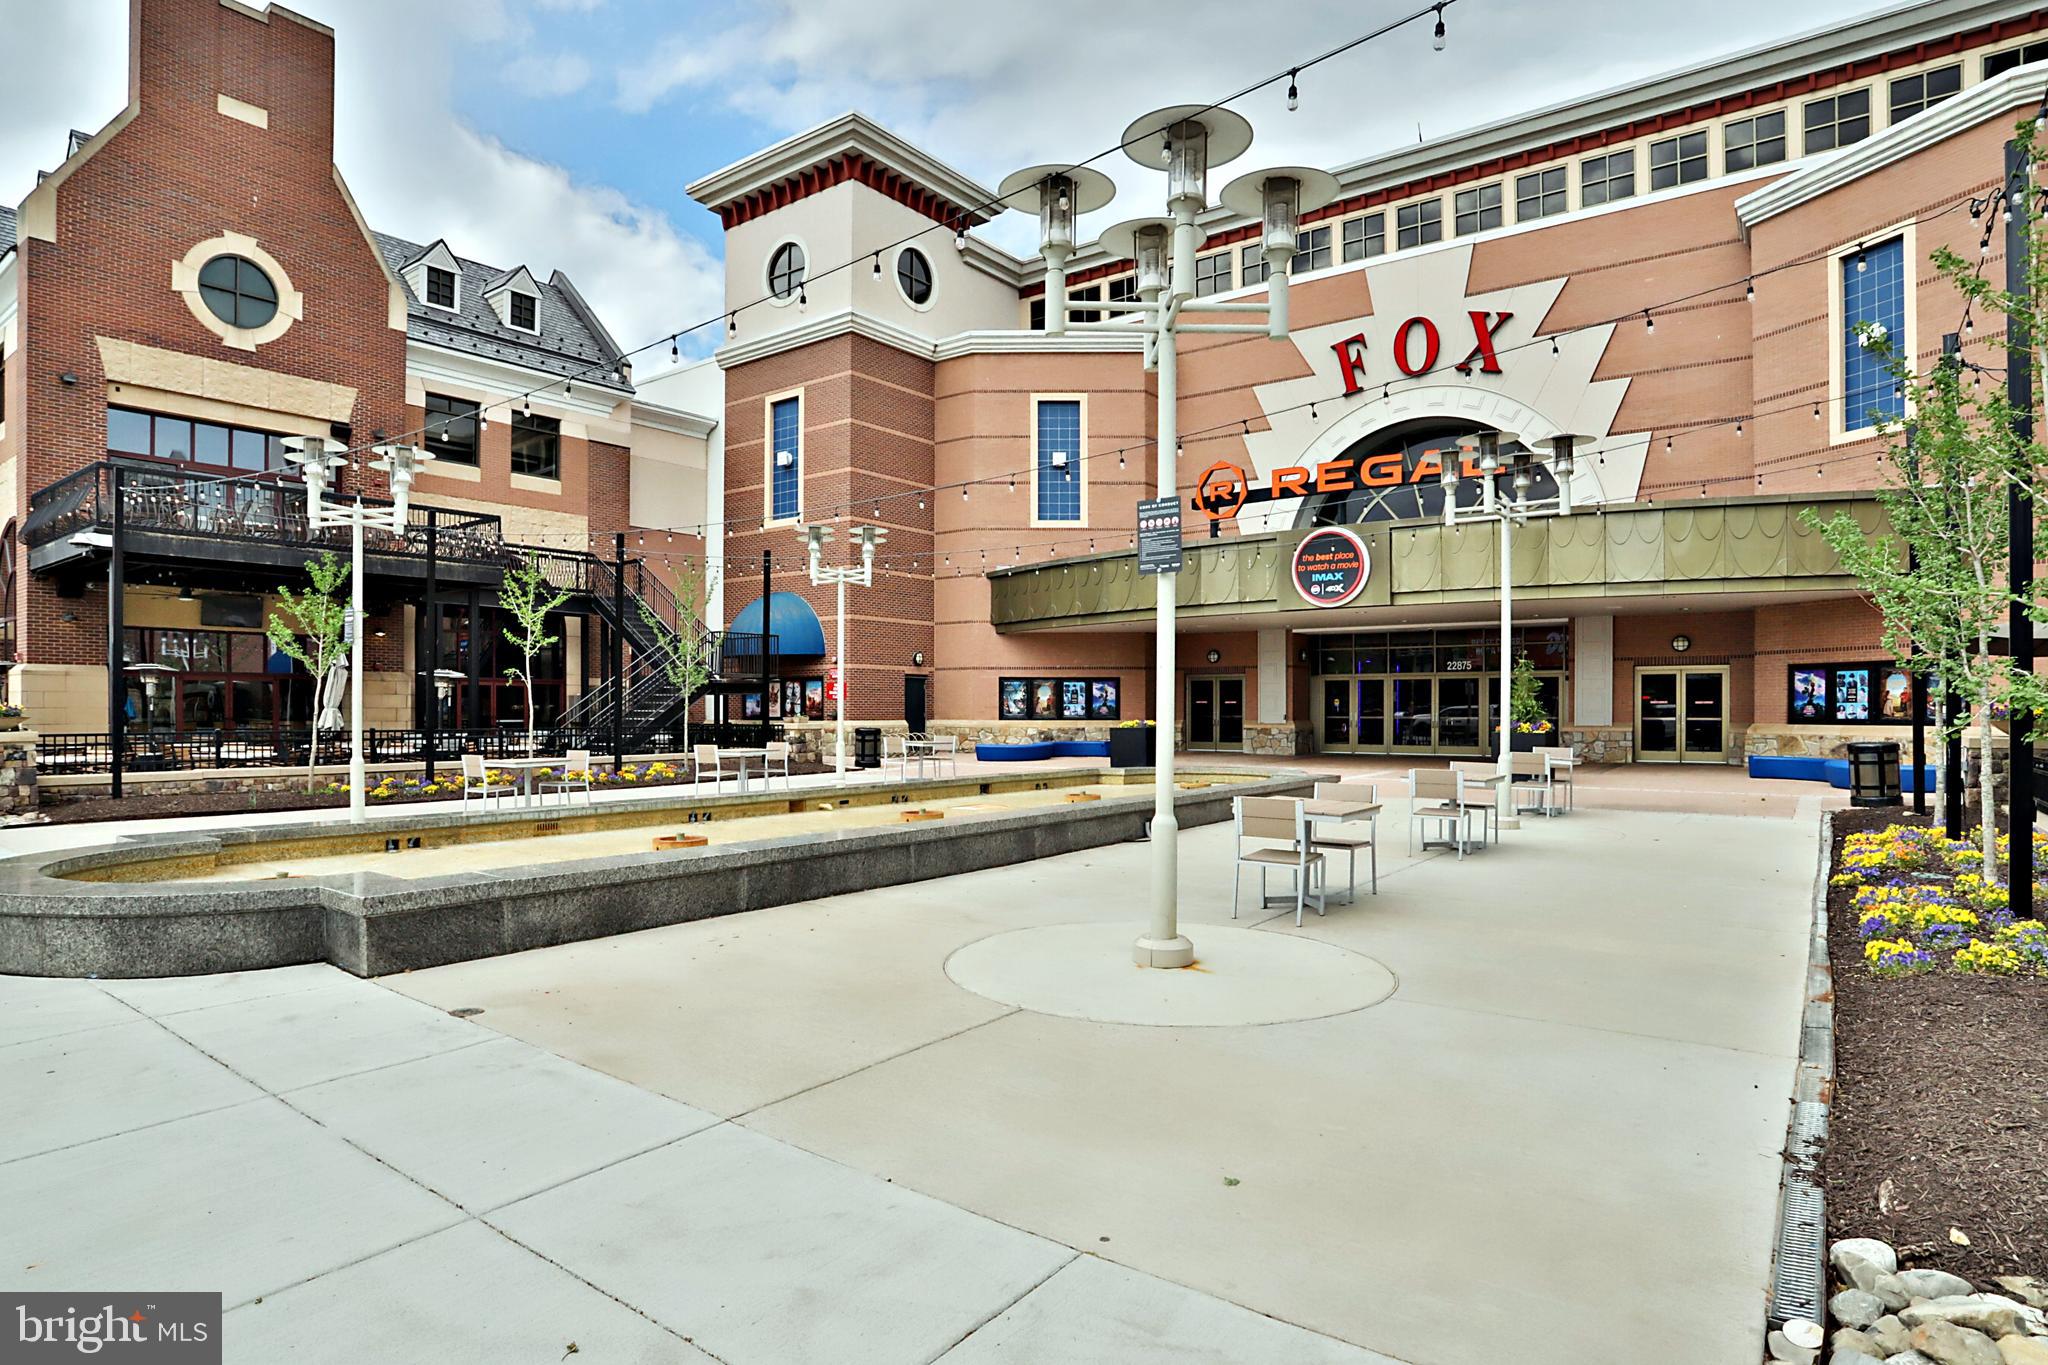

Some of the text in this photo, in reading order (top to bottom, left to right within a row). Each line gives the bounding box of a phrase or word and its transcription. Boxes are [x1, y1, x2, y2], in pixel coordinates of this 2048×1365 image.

[1330, 311, 1514, 398] FOX
[1210, 445, 1506, 502] R REGAL
[1315, 553, 1333, 561] best
[1334, 552, 1354, 561] place
[1307, 563, 1329, 571] watch
[1337, 561, 1359, 569] movie
[1311, 572, 1344, 581] IMAX
[1447, 661, 1472, 670] 22875
